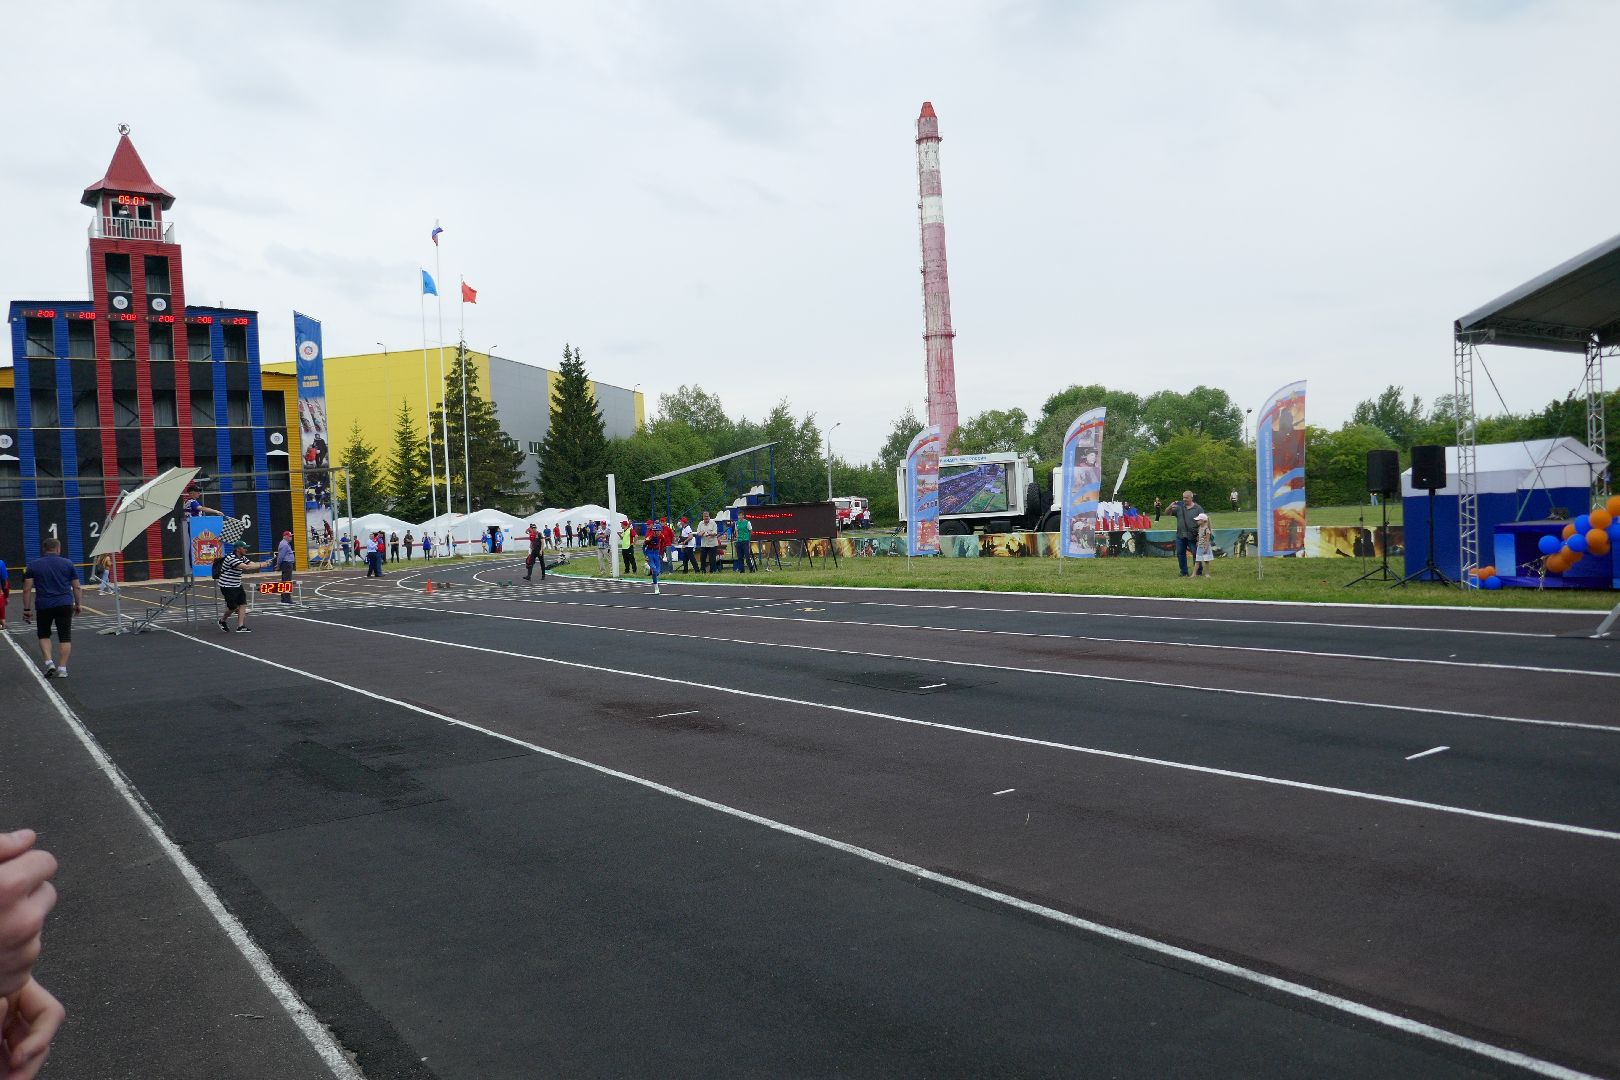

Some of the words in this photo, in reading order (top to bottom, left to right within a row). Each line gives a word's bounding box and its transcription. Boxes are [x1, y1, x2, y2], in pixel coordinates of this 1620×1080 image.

[90, 521, 101, 538] 2
[167, 517, 177, 533] 4
[241, 514, 251, 529] 6
[49, 523, 58, 539] 1
